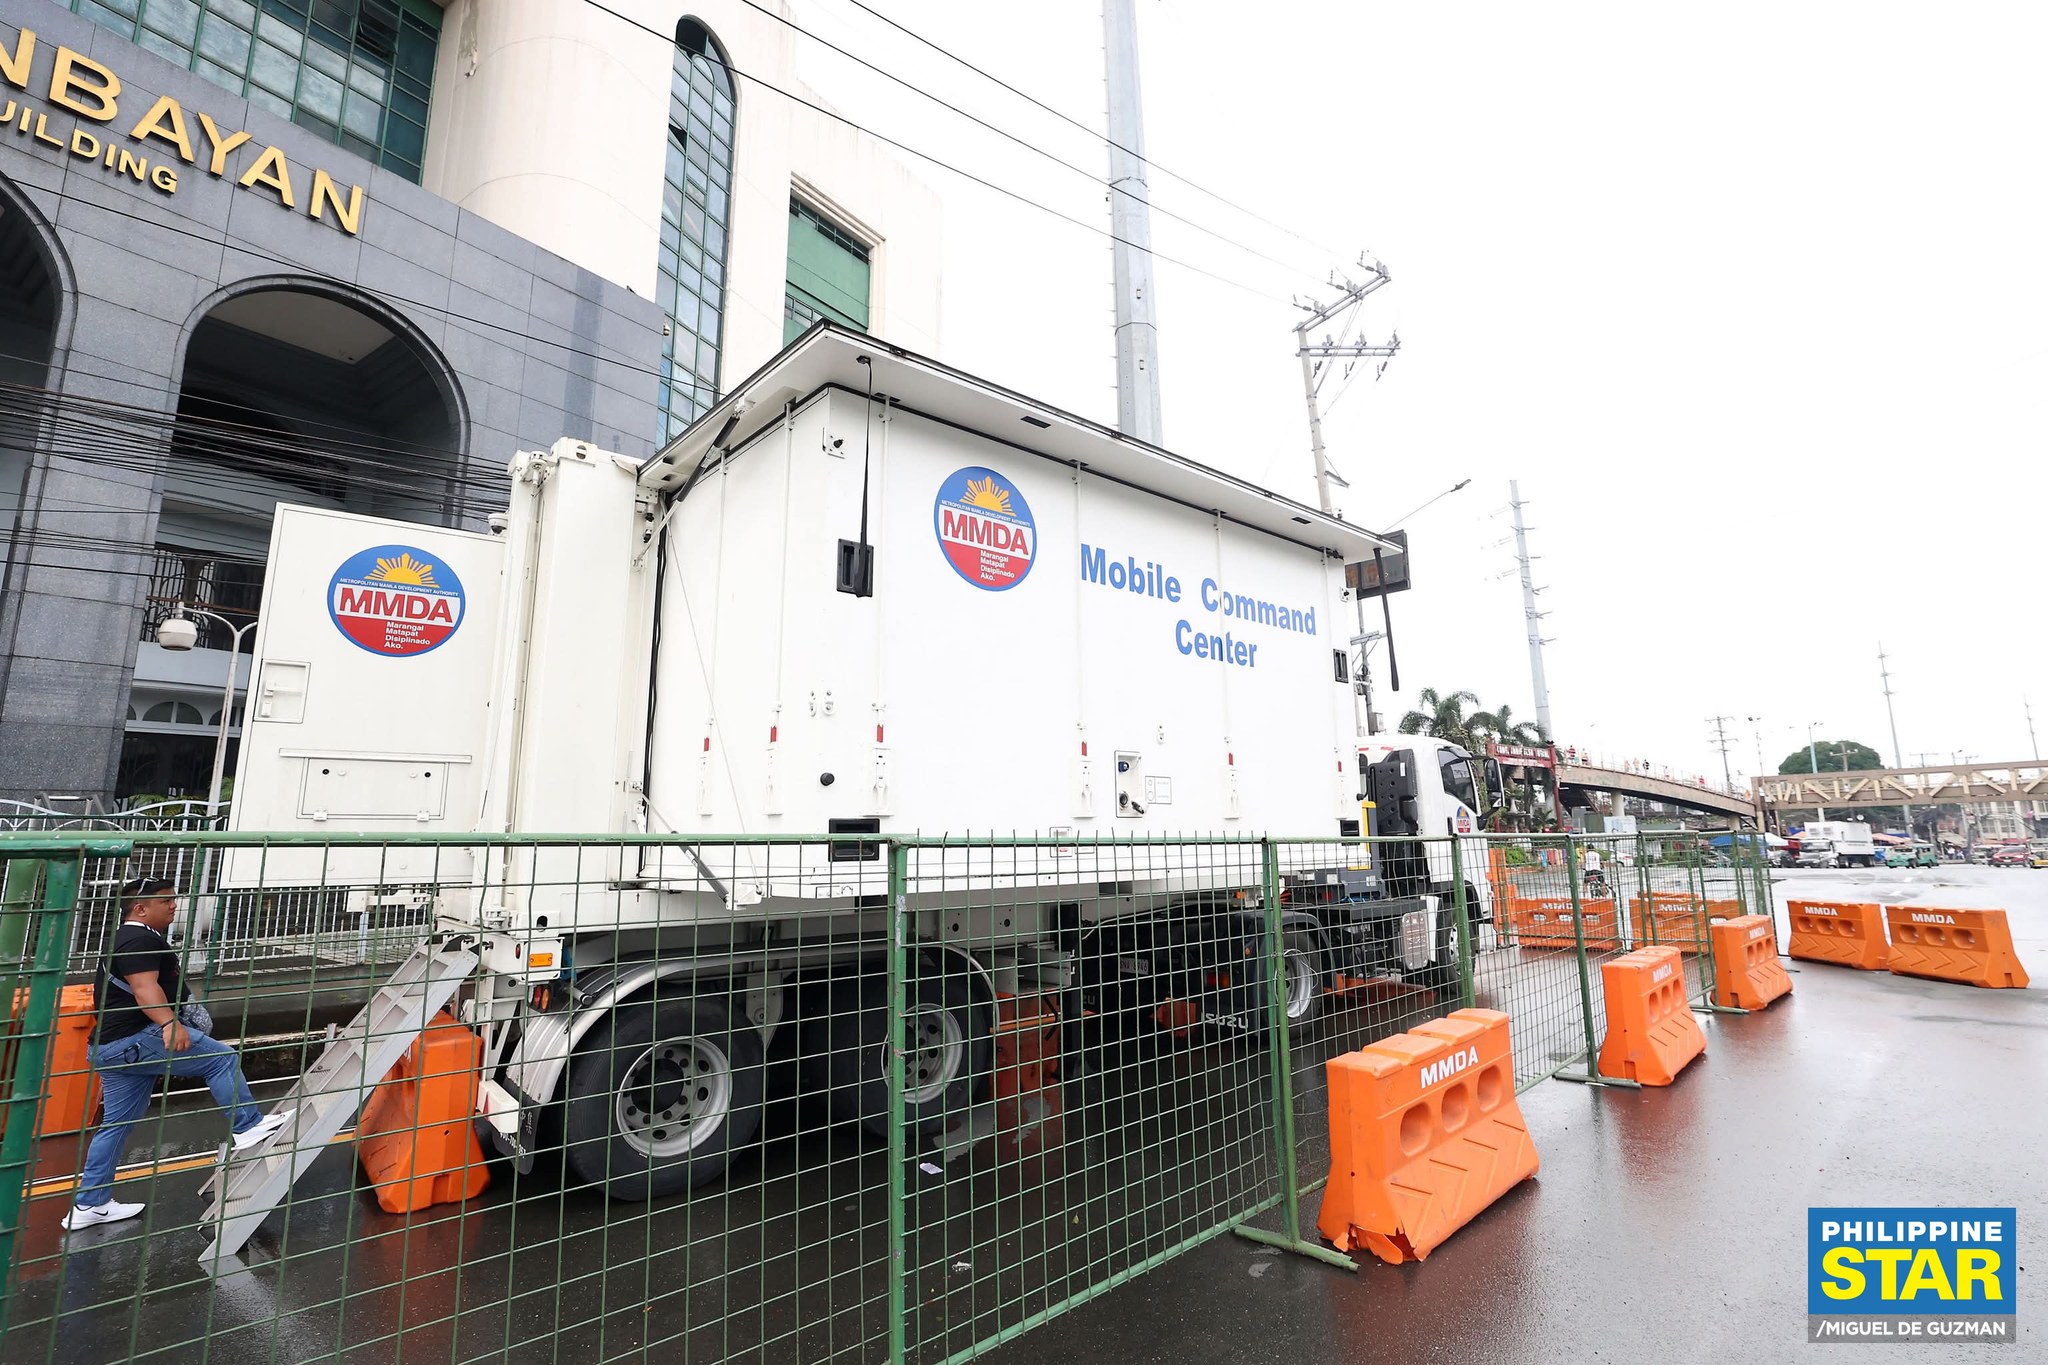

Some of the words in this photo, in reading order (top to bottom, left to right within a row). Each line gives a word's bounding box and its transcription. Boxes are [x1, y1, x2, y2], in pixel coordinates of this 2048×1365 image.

[944, 509, 1029, 555] MMDA
[980, 550, 1009, 563] Marangal
[980, 557, 1005, 568] Matapat
[980, 565, 1015, 578] Disiplinado
[980, 572, 996, 582] Ako.
[340, 577, 379, 587] METROPOLITAN
[379, 582, 398, 590] MANILA
[398, 584, 433, 594] DEVELOPMENT
[433, 589, 460, 597] AUTHORITY
[1080, 543, 1182, 603] Mobile
[1201, 577, 1317, 636] Command
[339, 587, 453, 623] MMDA
[385, 627, 419, 637] Matapat
[386, 621, 425, 631] Marangal
[384, 641, 404, 650] Ako.
[385, 634, 431, 646] Disiplinado
[1175, 619, 1258, 668] Center
[1804, 906, 1838, 916] MMDA
[1911, 913, 1956, 925] MMDA
[1652, 962, 1673, 984] MMDA
[1420, 1045, 1479, 1089] MMDA
